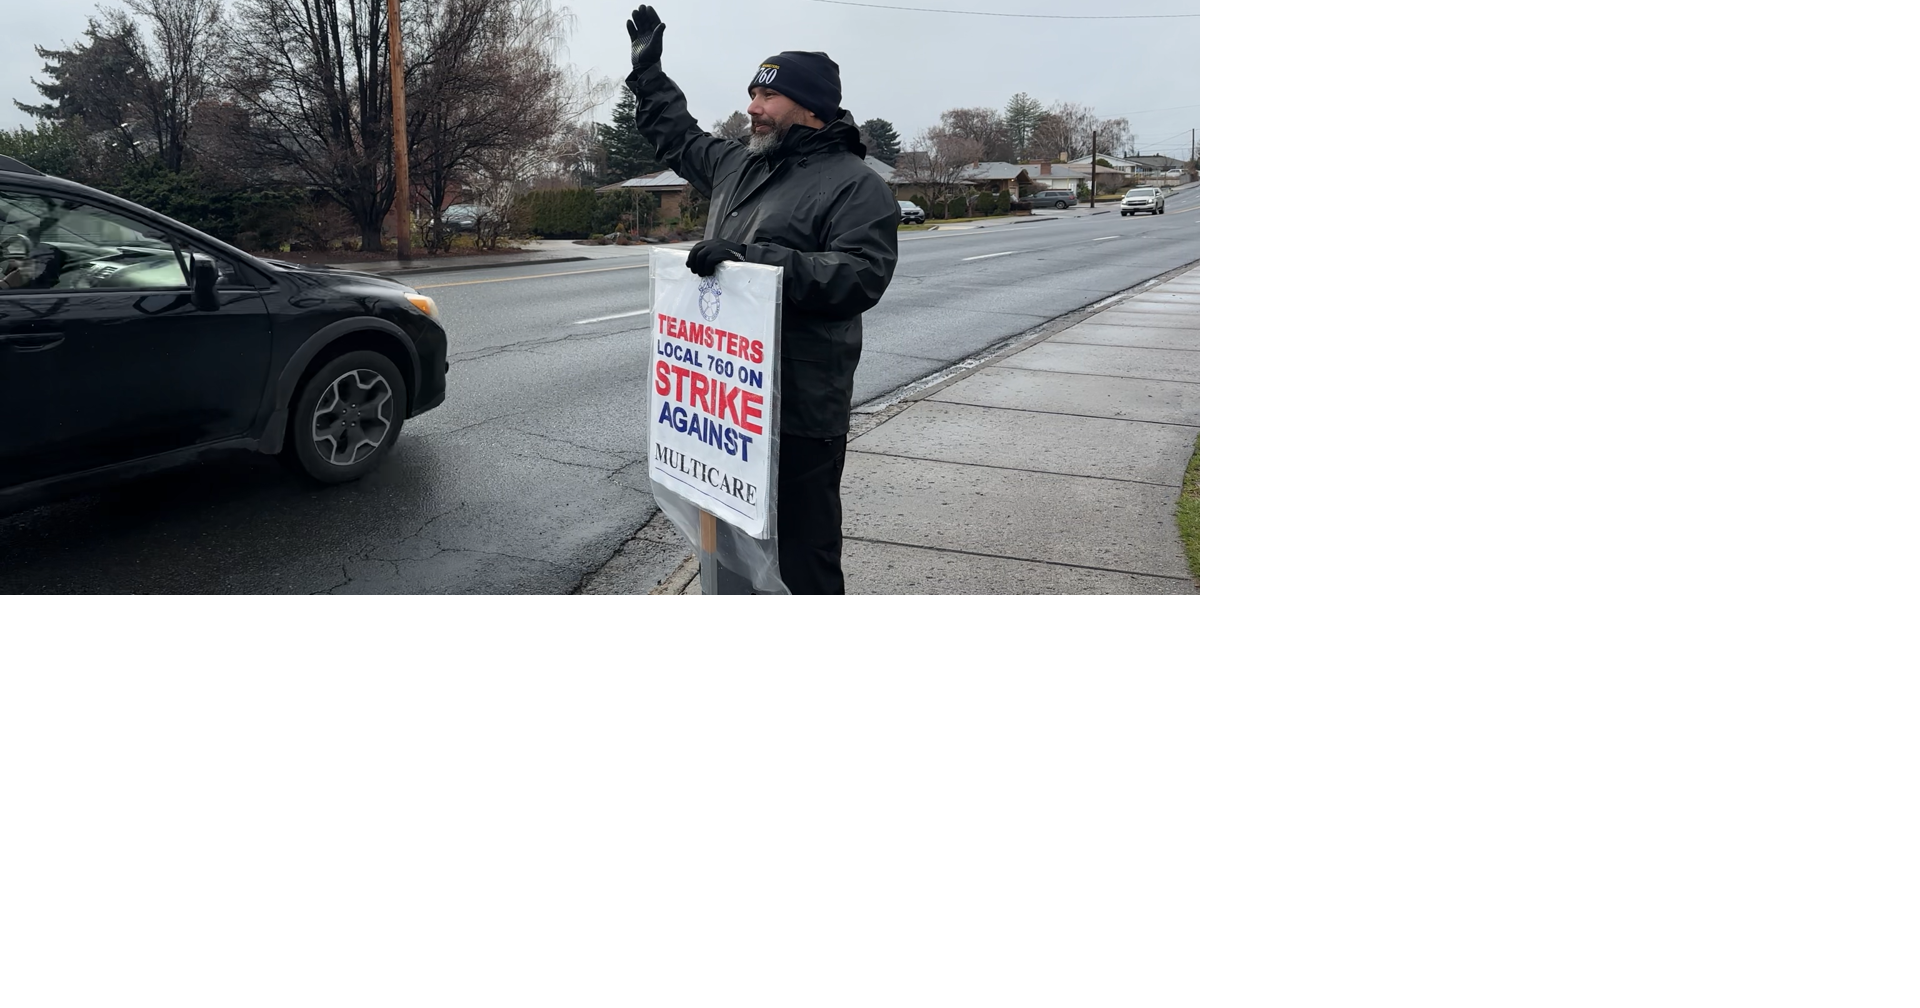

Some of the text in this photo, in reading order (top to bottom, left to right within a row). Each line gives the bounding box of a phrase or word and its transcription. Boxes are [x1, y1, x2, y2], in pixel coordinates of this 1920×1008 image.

[657, 339, 763, 389] LOCAL 760 ON
[658, 313, 764, 364] TEAMSTERS
[655, 360, 764, 435] STRIKE
[658, 401, 753, 462] AGAINST
[655, 443, 757, 506] MULTICARE
